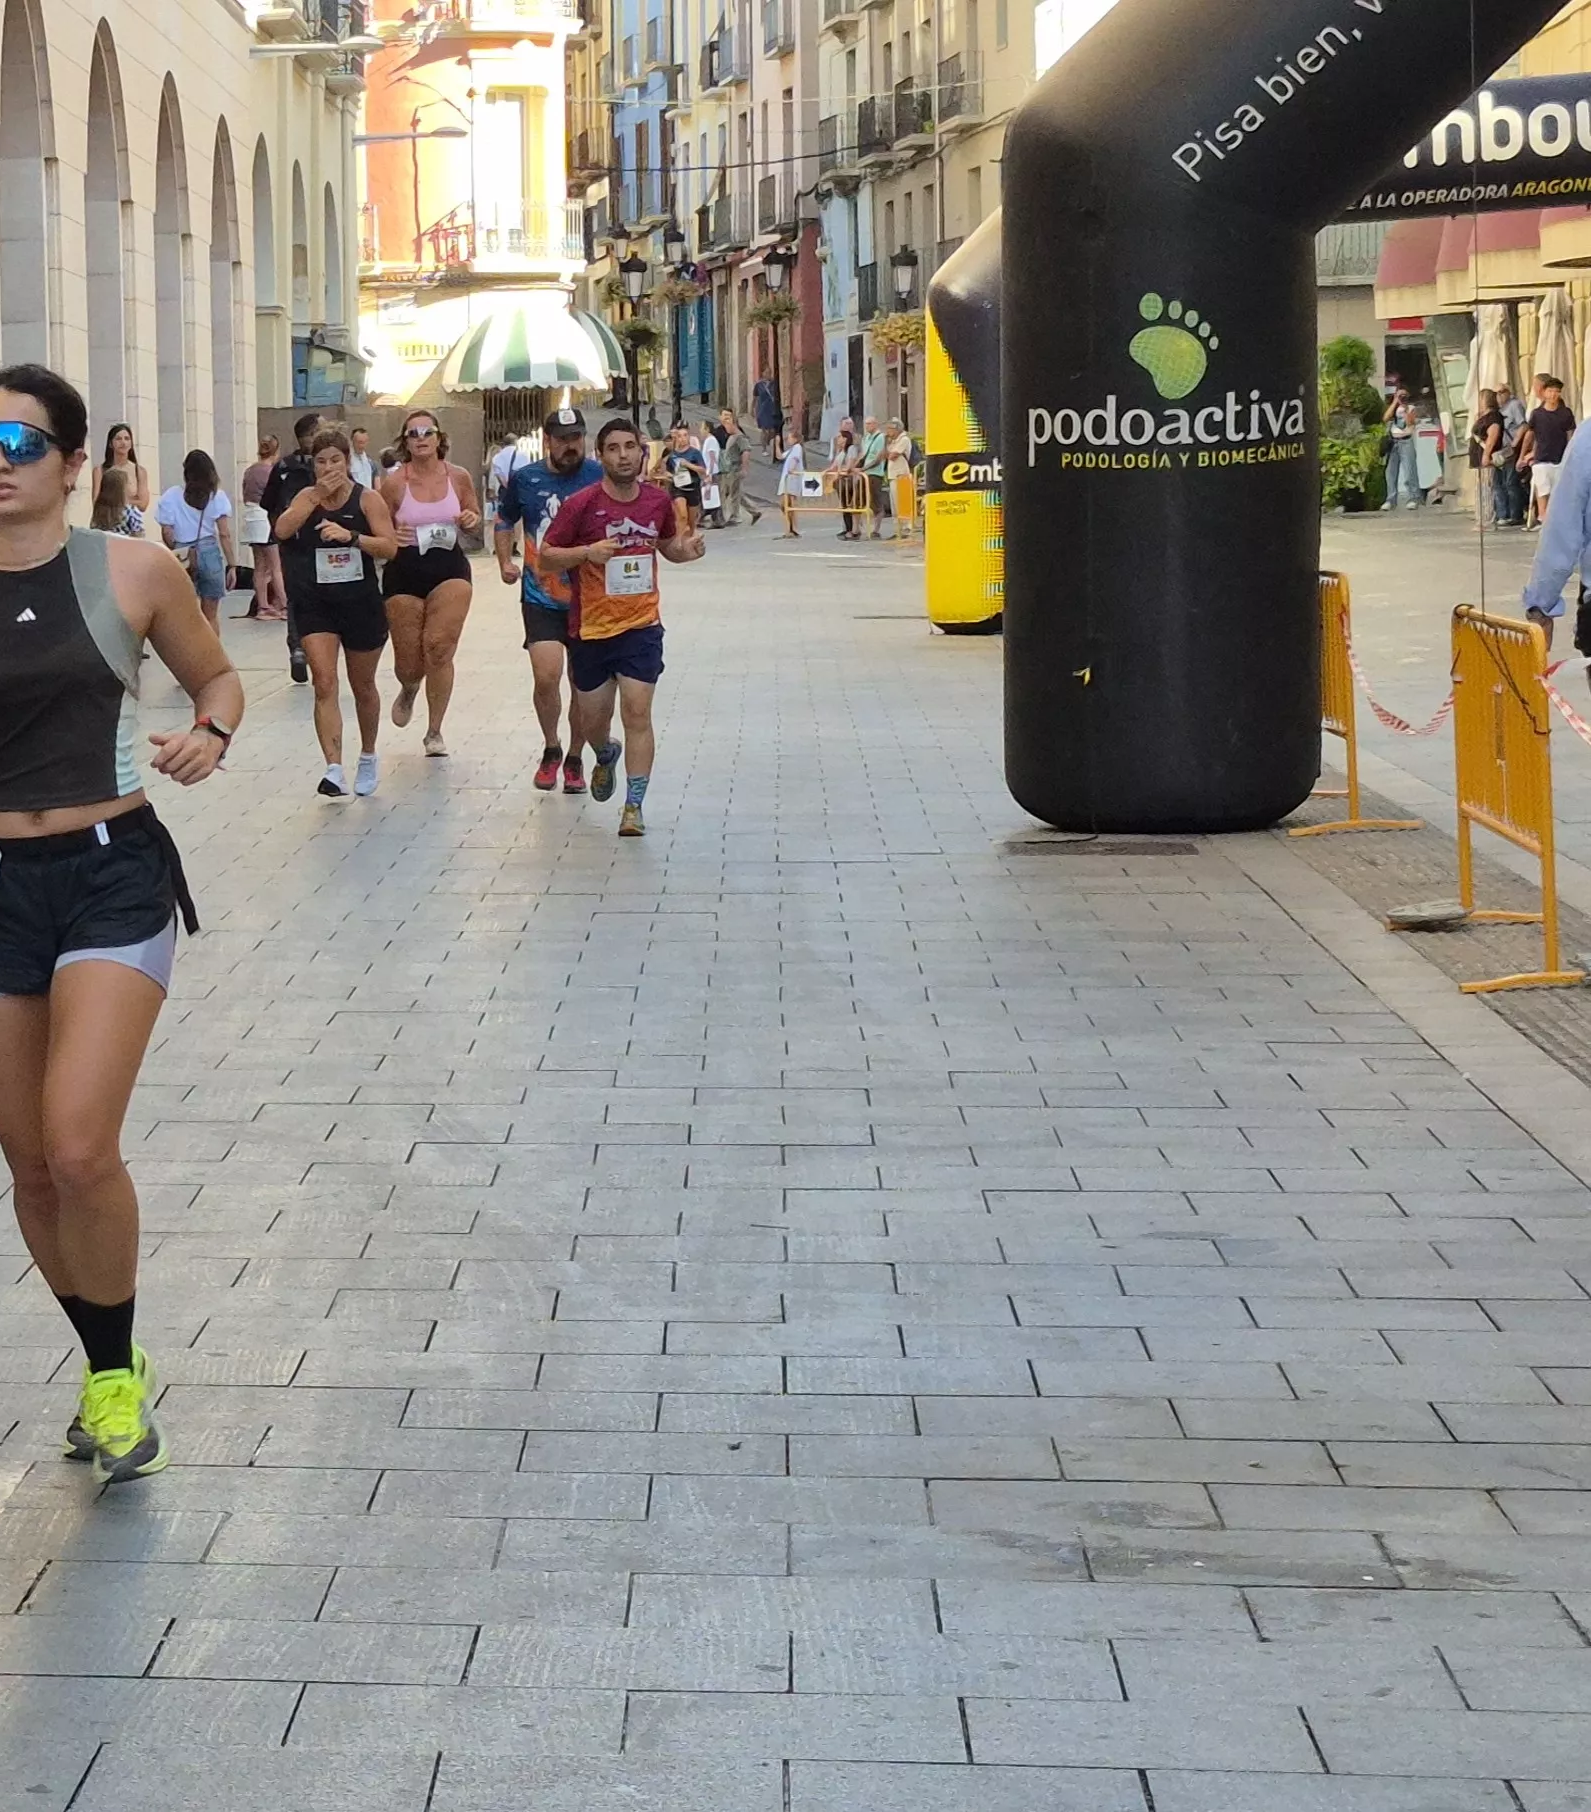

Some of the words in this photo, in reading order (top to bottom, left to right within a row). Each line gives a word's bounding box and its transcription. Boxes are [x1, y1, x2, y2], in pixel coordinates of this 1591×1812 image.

[1171, 103, 1266, 183] Pisa
[1254, 25, 1363, 106] bien,
[1360, 193, 1373, 209] A
[1376, 192, 1397, 204] LA
[1400, 183, 1508, 207] OPERADORA
[1027, 389, 1306, 468] podoactiva
[1061, 449, 1171, 469] PODOLOGÍA
[1178, 451, 1189, 467] Y
[1197, 442, 1306, 468] BIOMECÁNICA
